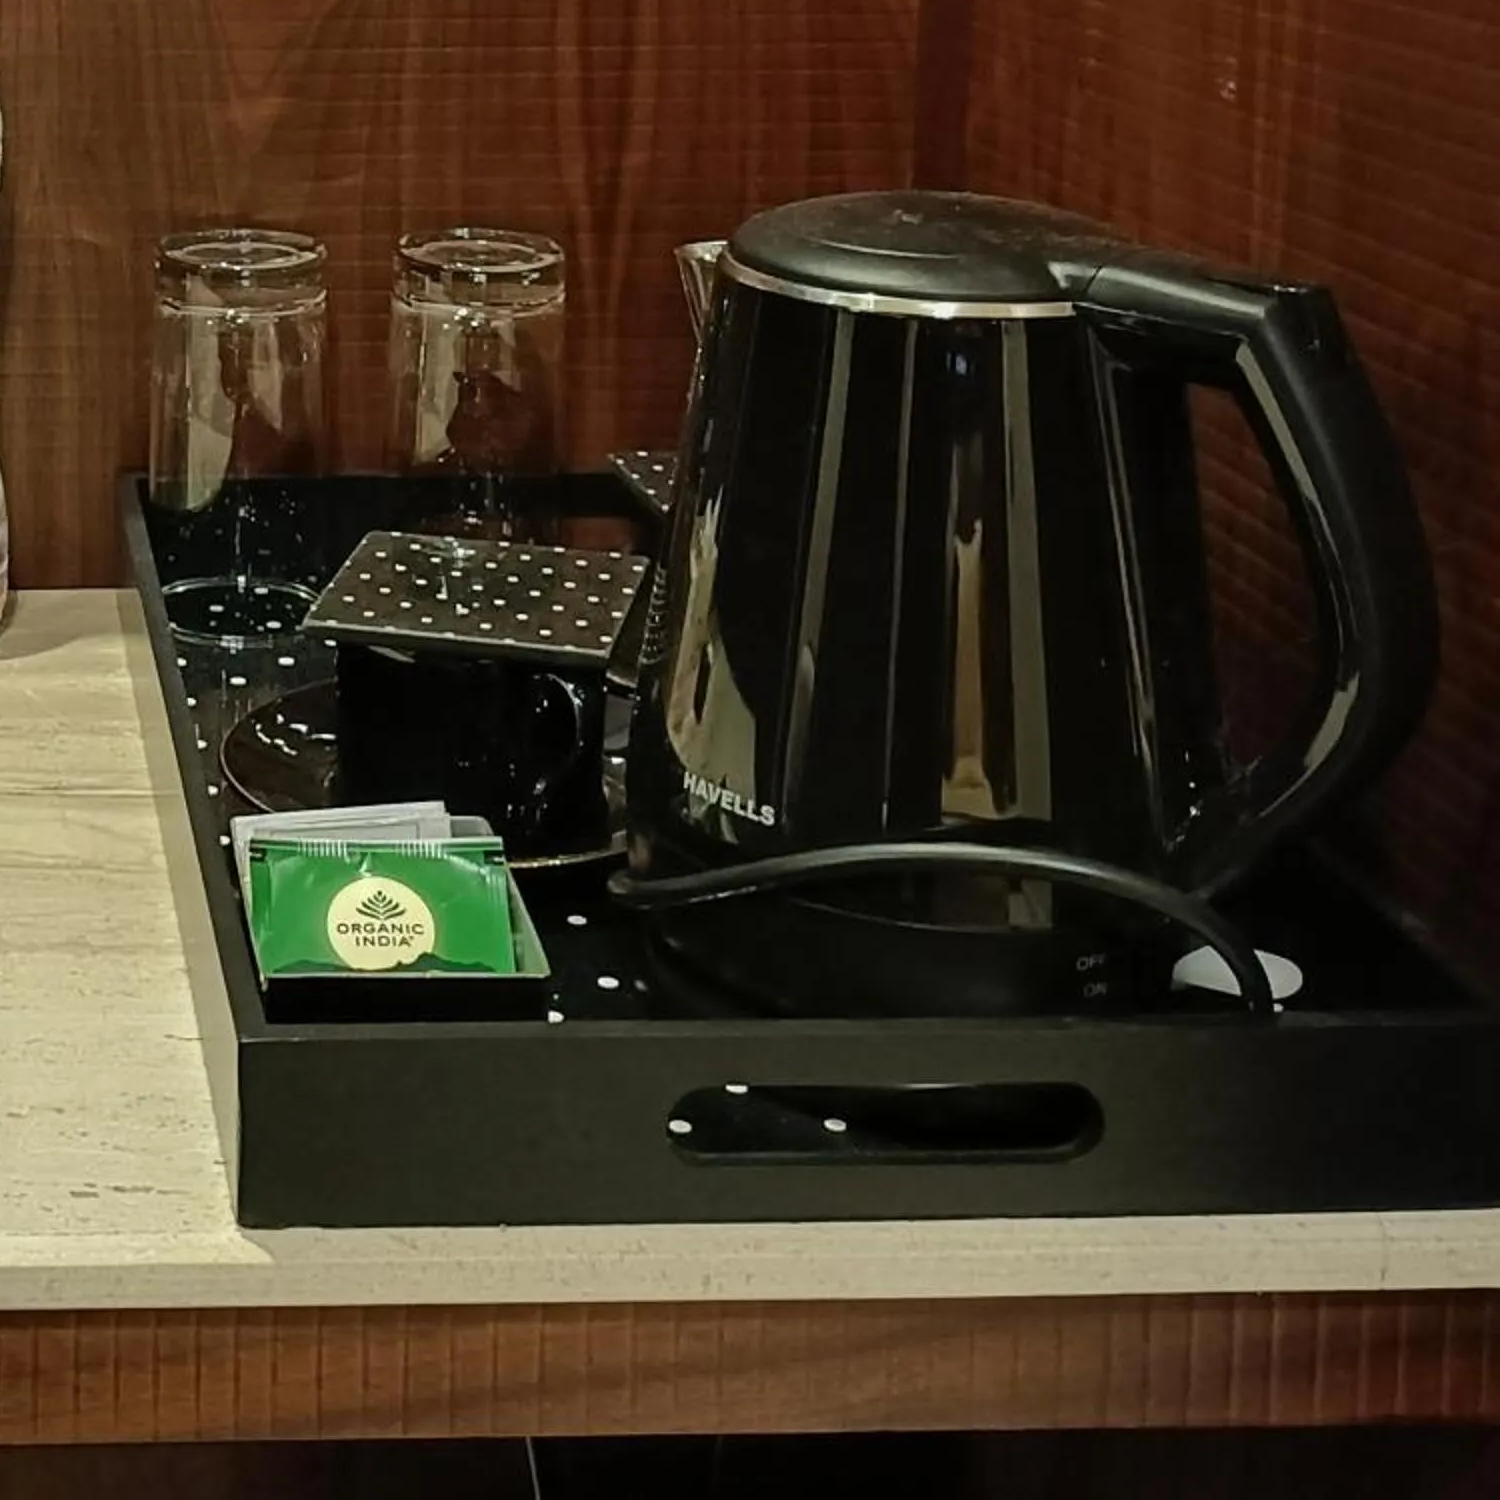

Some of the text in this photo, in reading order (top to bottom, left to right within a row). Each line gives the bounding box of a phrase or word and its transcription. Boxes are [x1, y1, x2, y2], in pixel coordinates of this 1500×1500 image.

[683, 771, 775, 826] HAVELLS
[336, 923, 425, 947] ORGANIC INDIA
